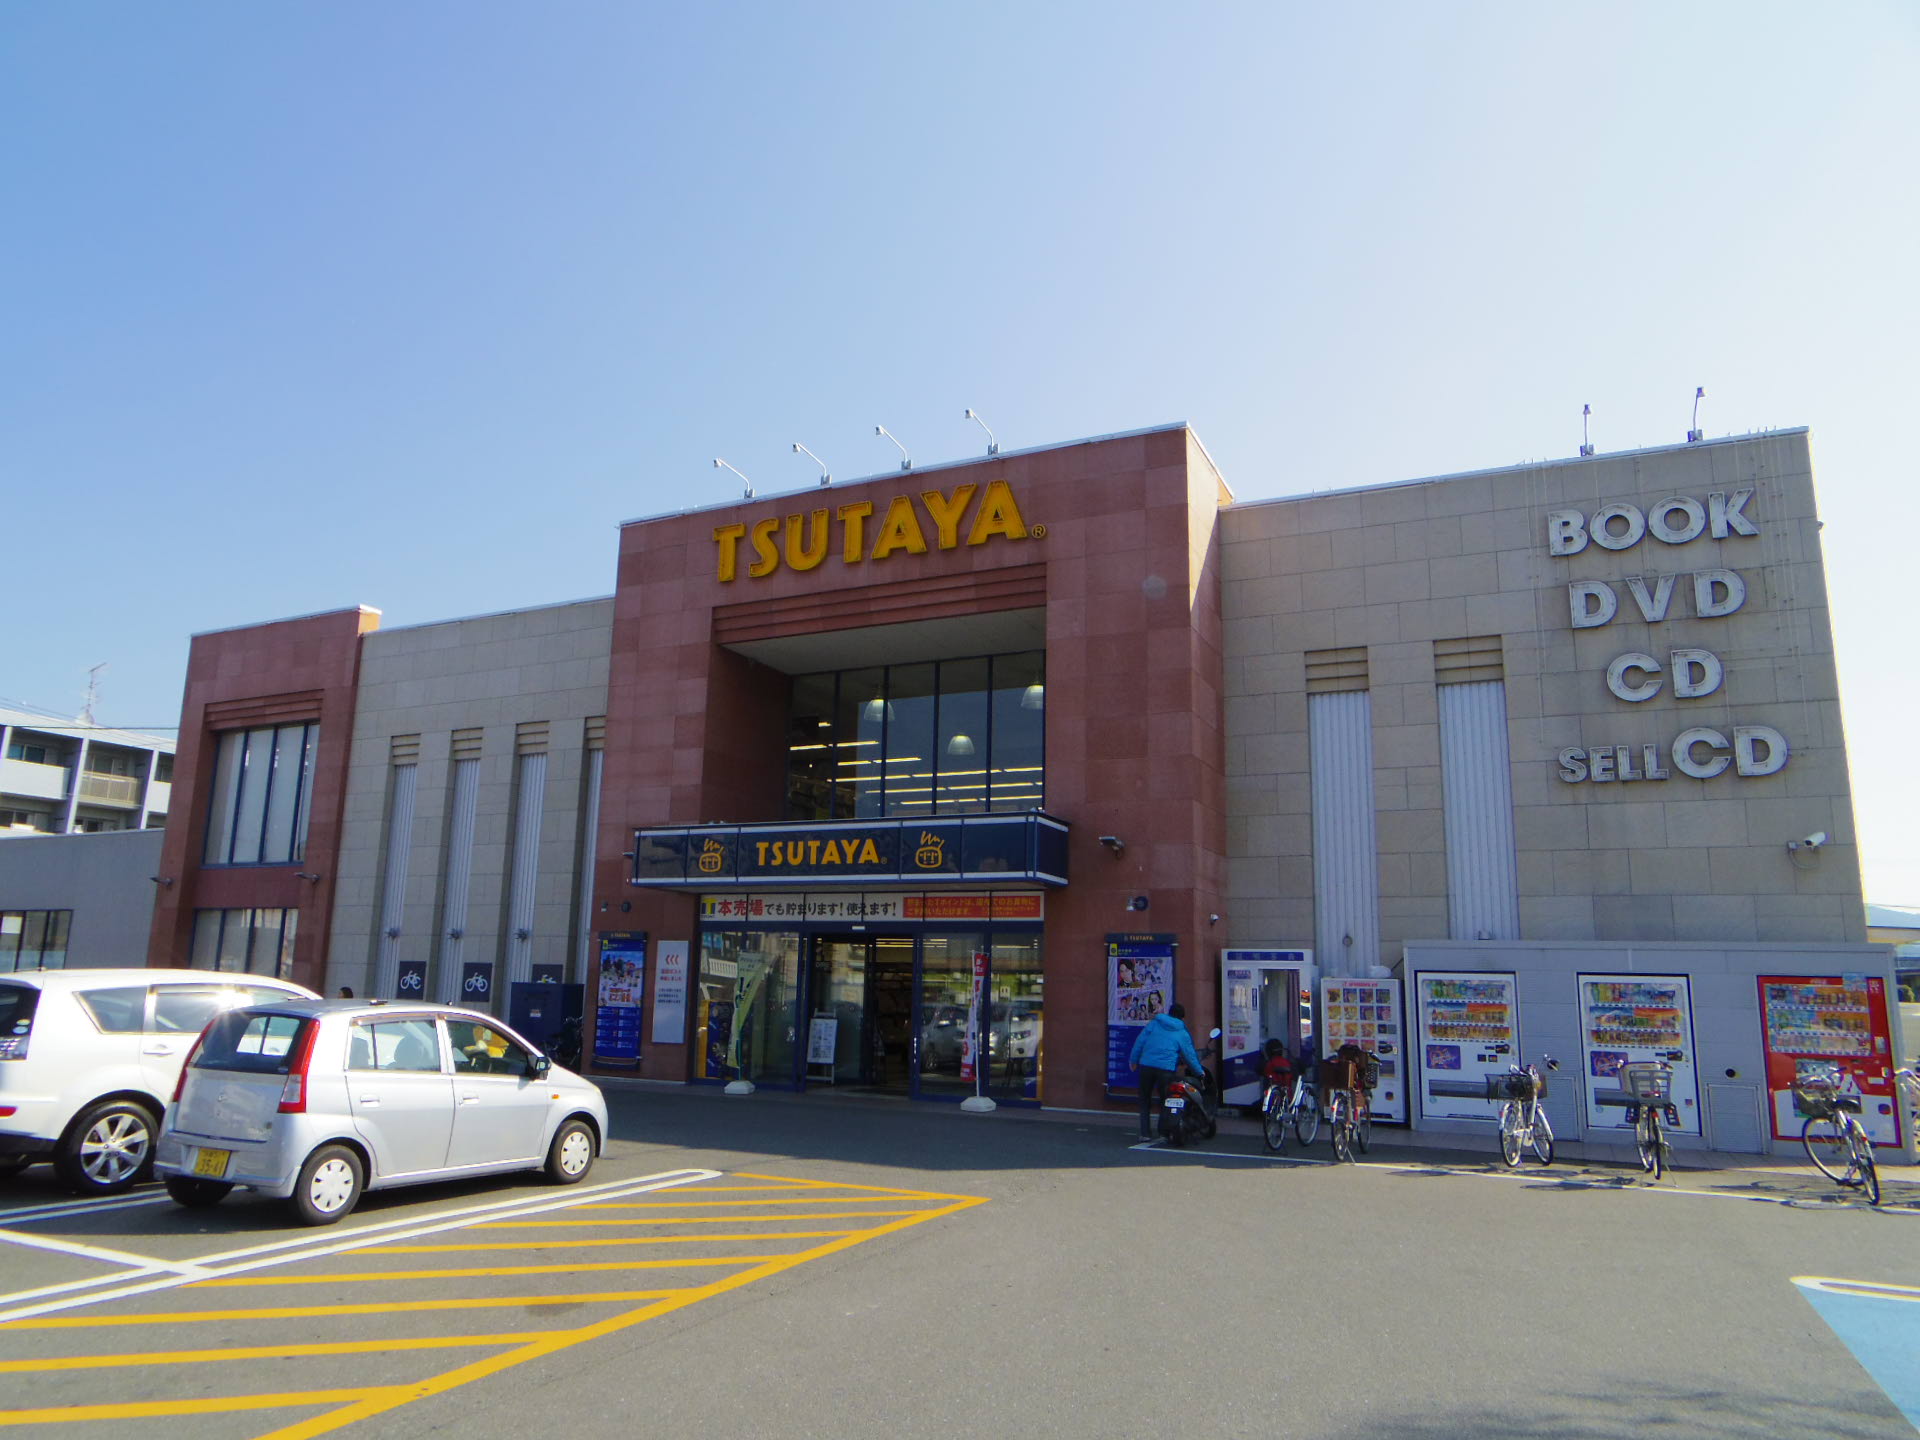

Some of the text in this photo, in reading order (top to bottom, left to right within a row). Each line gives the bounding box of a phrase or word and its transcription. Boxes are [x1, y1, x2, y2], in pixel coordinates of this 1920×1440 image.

[1548, 488, 1759, 557] BOOK
[1568, 568, 1747, 629] DVD
[1606, 648, 1724, 702] CD
[1558, 725, 1789, 784] SELL CD
[756, 838, 880, 866] TSUTAYA
